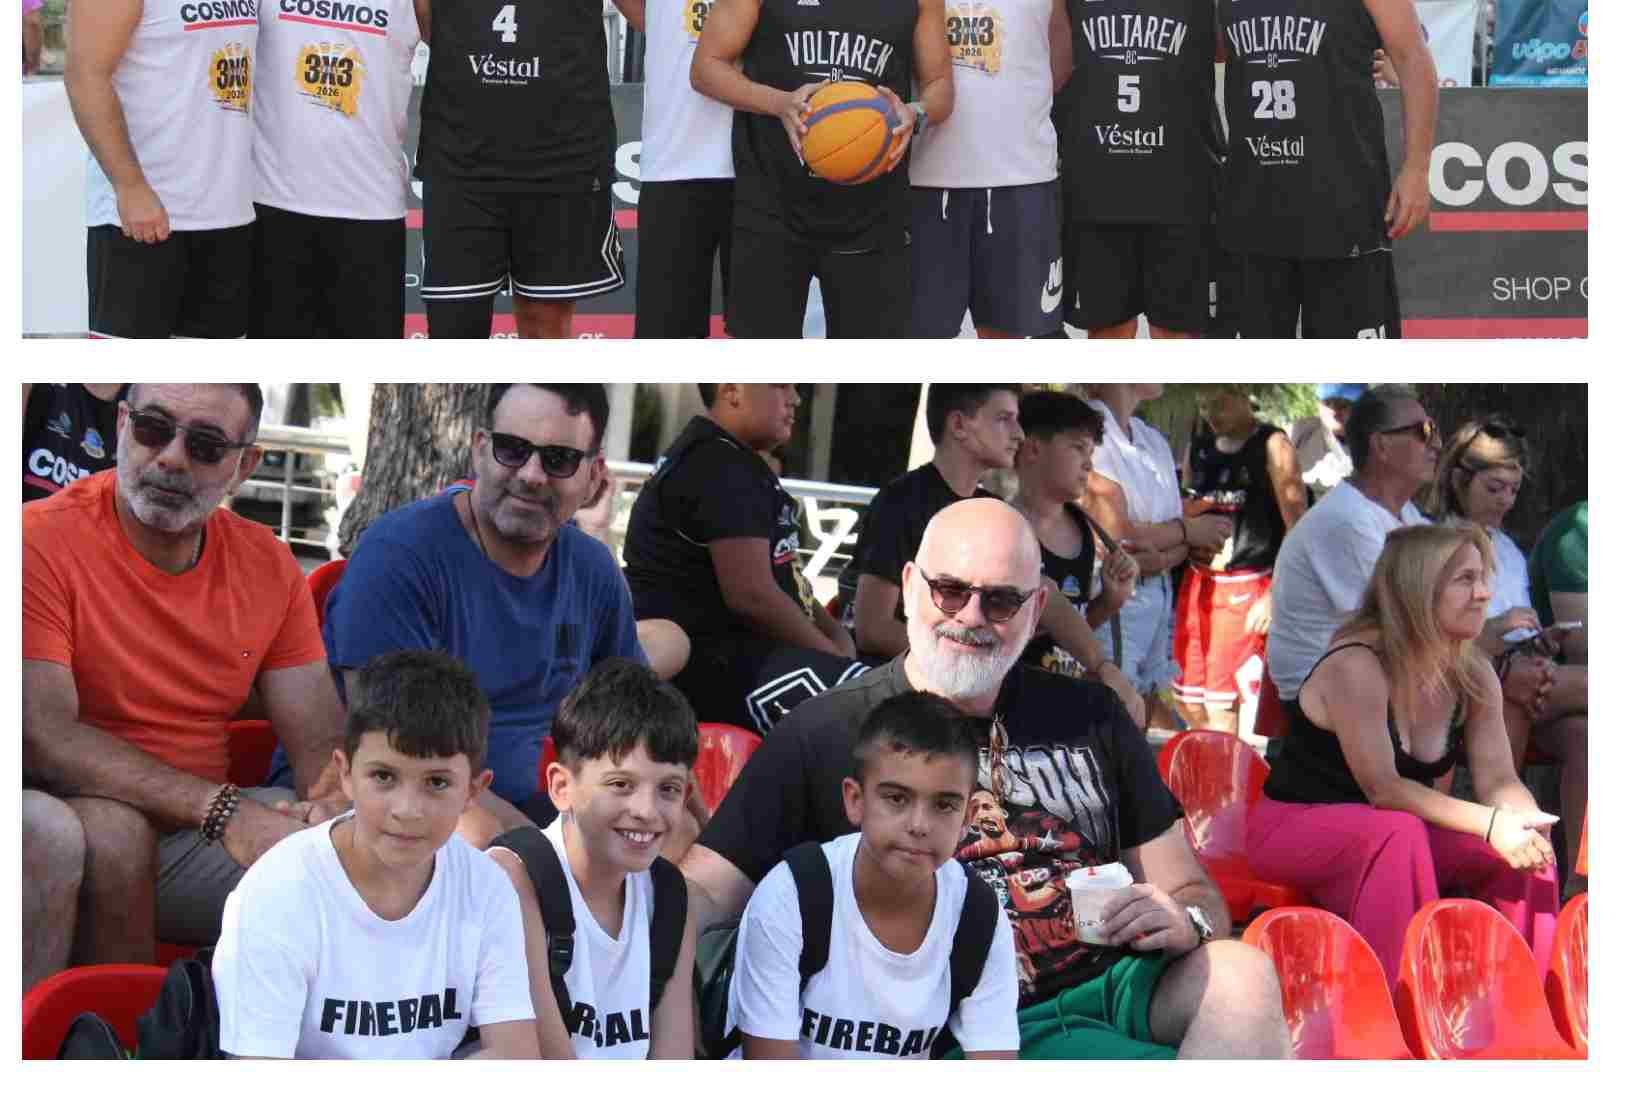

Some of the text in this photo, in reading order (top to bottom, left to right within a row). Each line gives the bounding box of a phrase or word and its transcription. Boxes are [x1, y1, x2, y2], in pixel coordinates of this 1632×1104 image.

[492, 4, 518, 43] 4
[946, 15, 994, 46] 3X3
[1082, 13, 1188, 57] VOLTAREN
[1226, 15, 1327, 57] VOLTAREN
[304, 52, 354, 87] 3X3
[468, 53, 540, 78] Véstal
[784, 29, 894, 76] VOLTAREN
[217, 56, 248, 90] 3X3
[1117, 75, 1141, 113] 5
[1251, 80, 1297, 120] 28
[1094, 122, 1165, 146] Véstal
[1245, 135, 1305, 157] Véstal
[1492, 276, 1571, 301] SHOP
